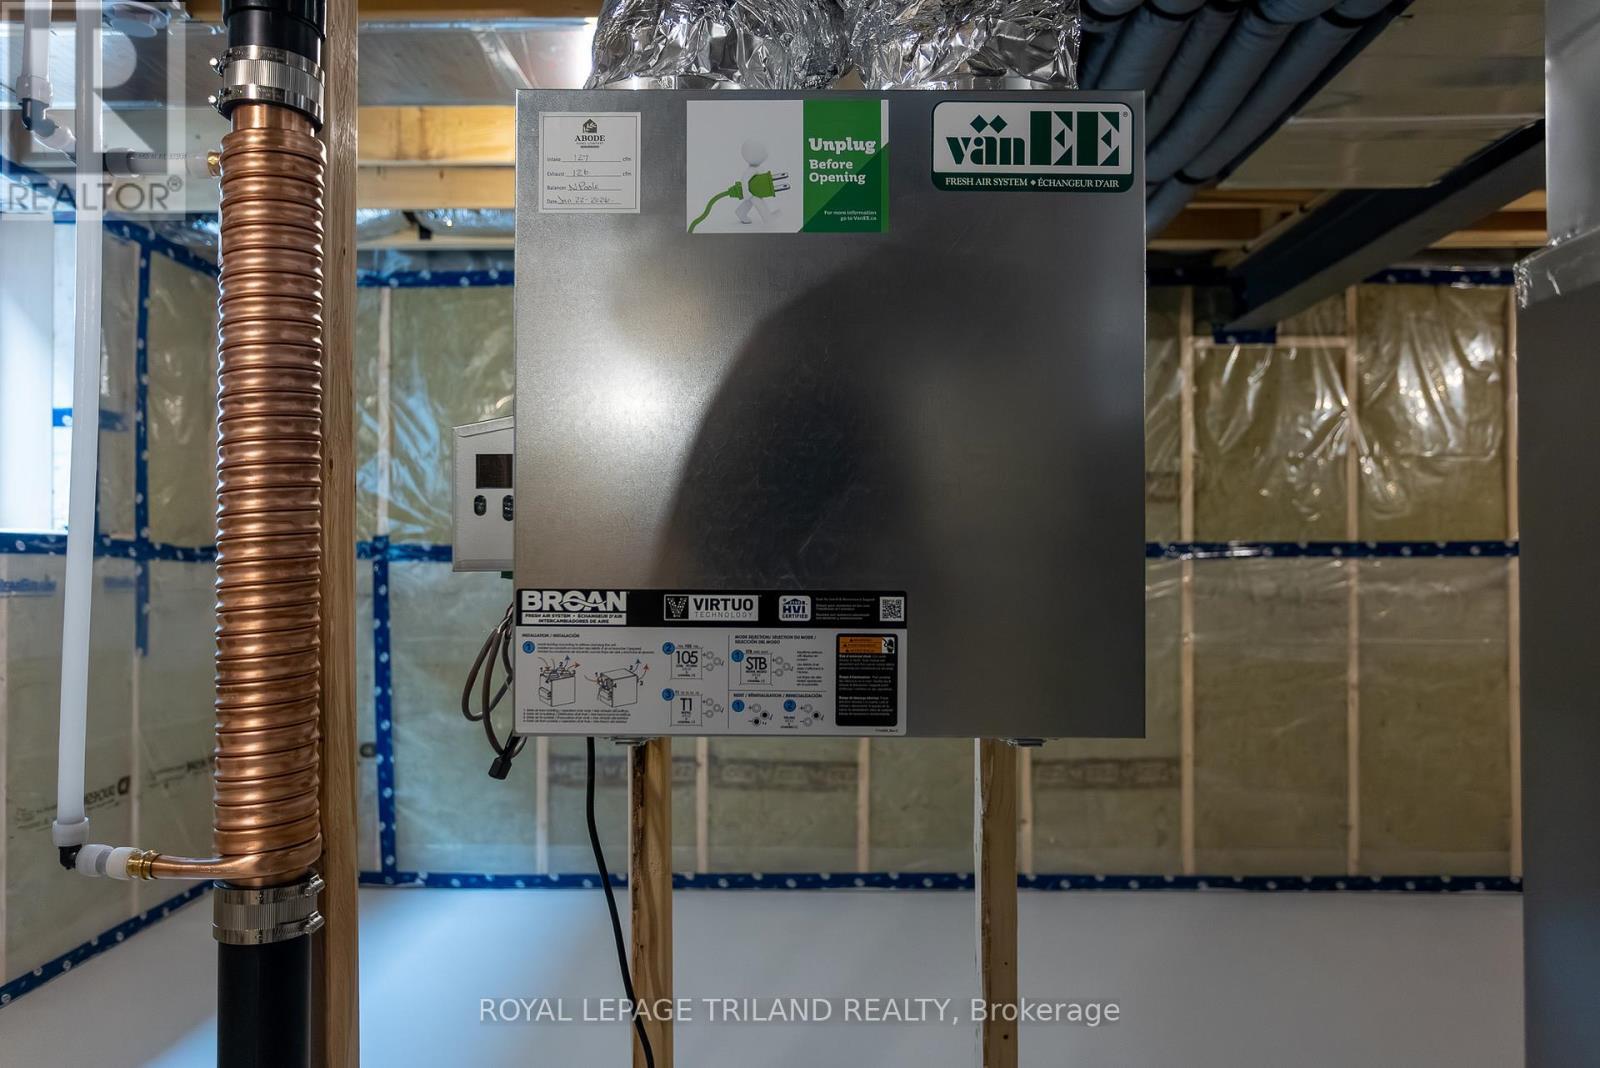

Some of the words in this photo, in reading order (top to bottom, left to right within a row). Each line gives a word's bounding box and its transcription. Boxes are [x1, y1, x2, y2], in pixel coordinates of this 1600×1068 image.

[808, 136, 876, 155] Unplug
[808, 159, 853, 169] Before
[808, 171, 866, 185] Opening
[945, 177, 974, 186] FRESH
[975, 178, 993, 186] AIR
[994, 178, 1028, 186] SYSTEM
[1037, 176, 1093, 187] ÉCHANGEUR
[1095, 179, 1119, 188] D'AIR
[521, 590, 627, 611] BROAN
[693, 598, 754, 611] VIRTUO
[783, 605, 806, 614] HVI
[676, 650, 698, 664] 105
[746, 656, 768, 670] STB
